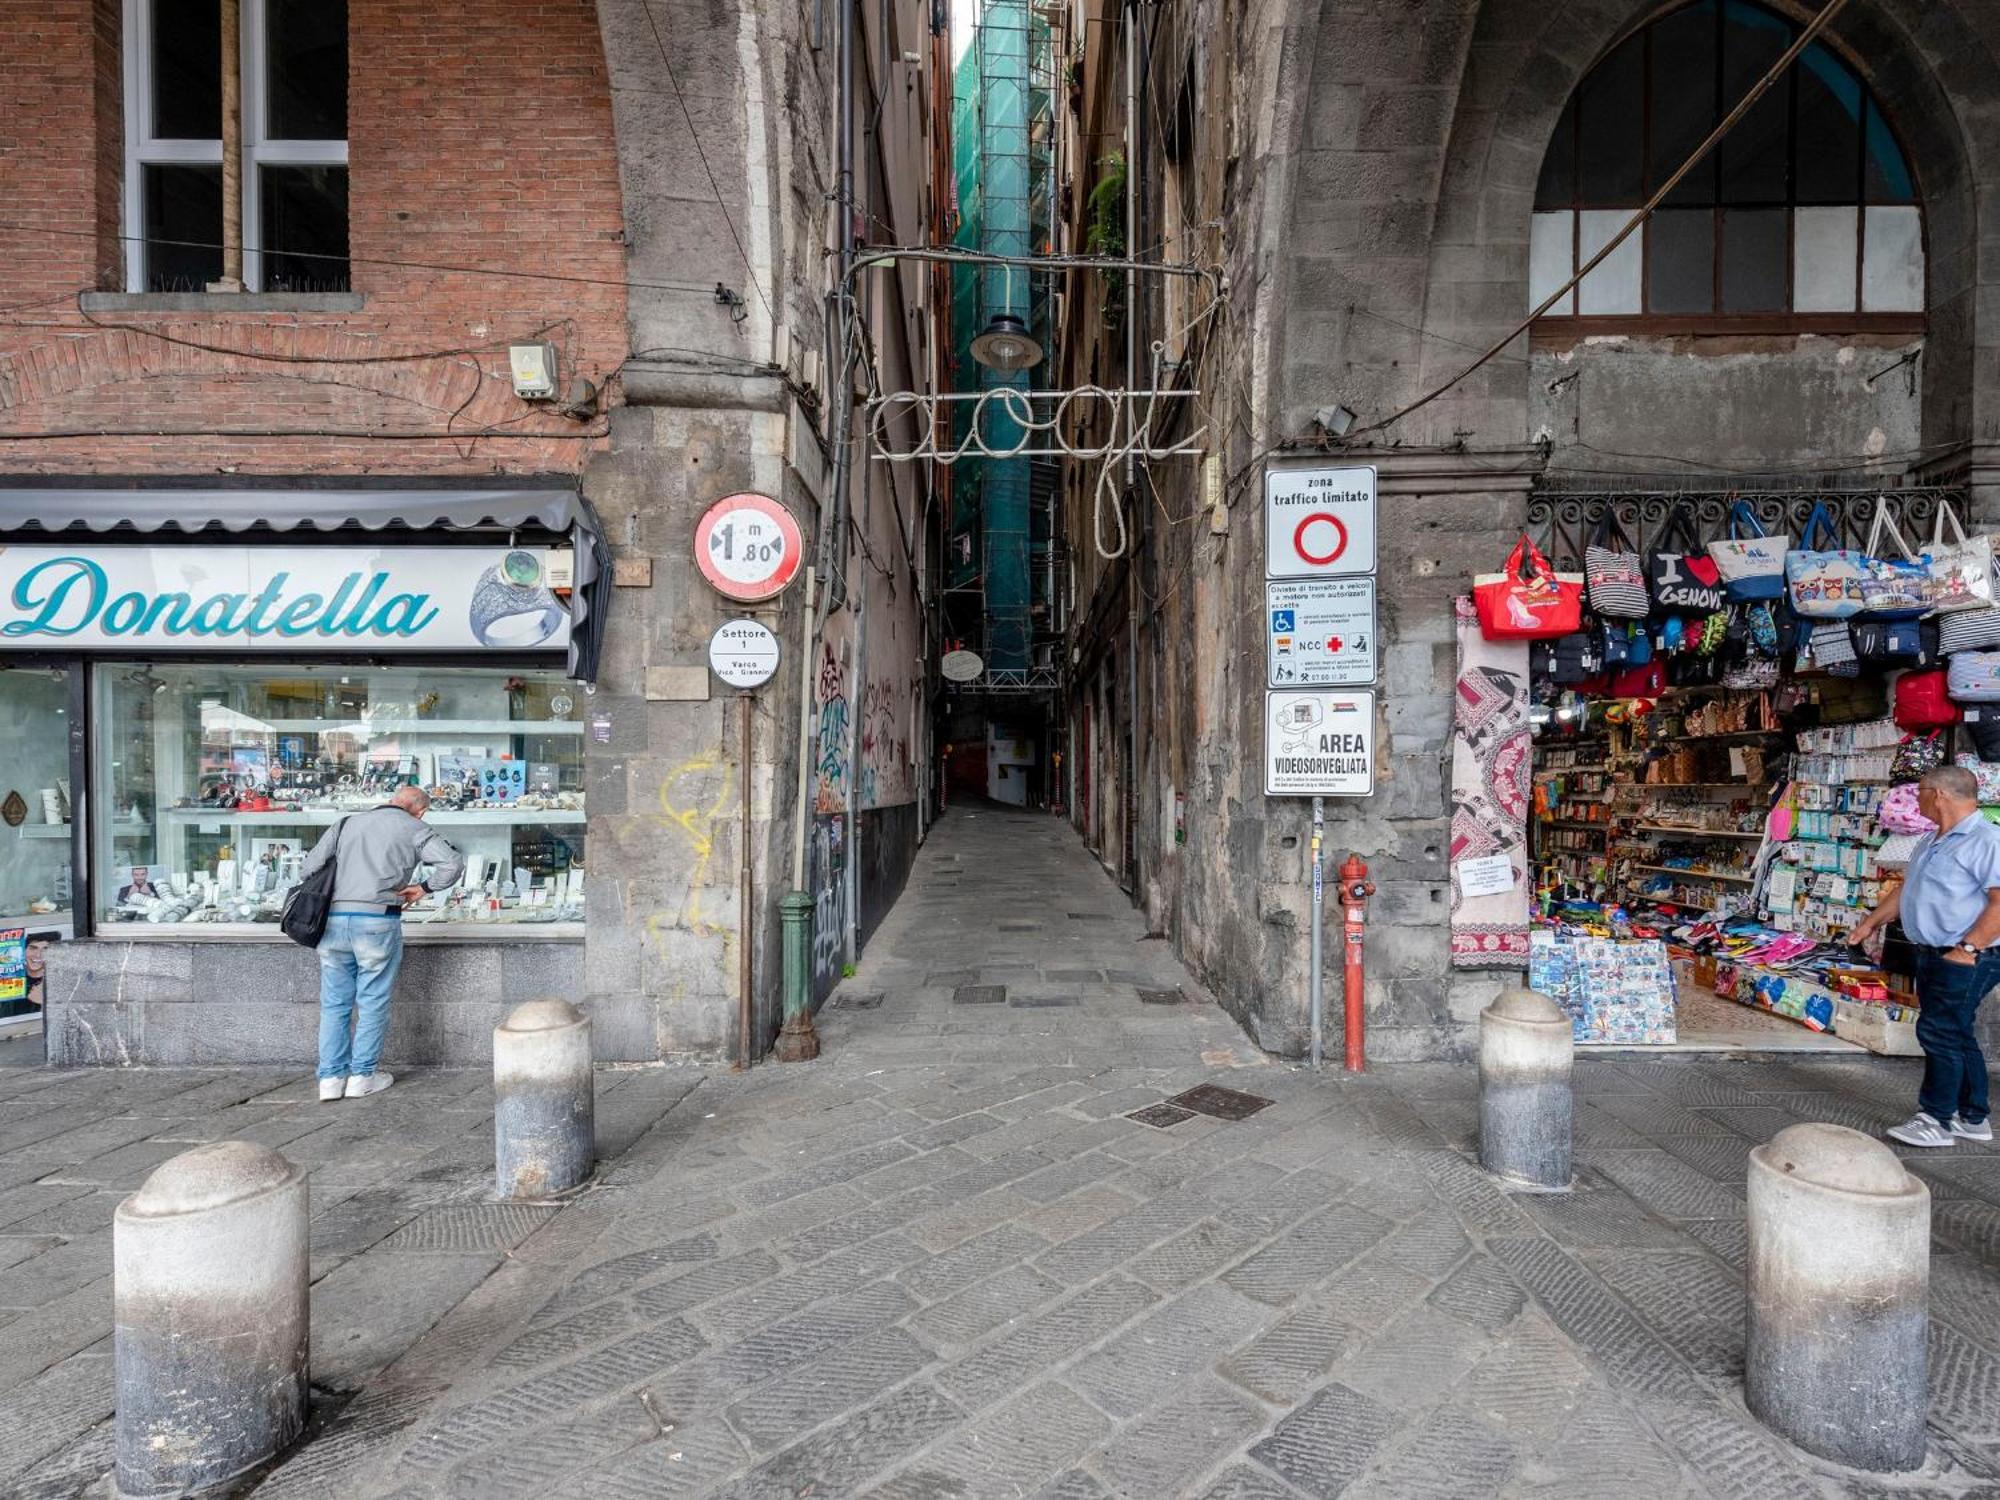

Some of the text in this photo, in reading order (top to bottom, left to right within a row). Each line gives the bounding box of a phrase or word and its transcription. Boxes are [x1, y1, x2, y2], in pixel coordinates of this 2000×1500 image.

[1308, 479, 1333, 487] zona
[1275, 491, 1369, 505] traffico limitato
[748, 525, 761, 536] m
[1656, 553, 1683, 585] I
[1, 556, 439, 637] Donatella
[722, 629, 766, 638] Settore
[1299, 641, 1321, 650] NCC
[1320, 734, 1365, 753] AREA
[1275, 758, 1368, 774] VIDEOSORVEGLIATA
